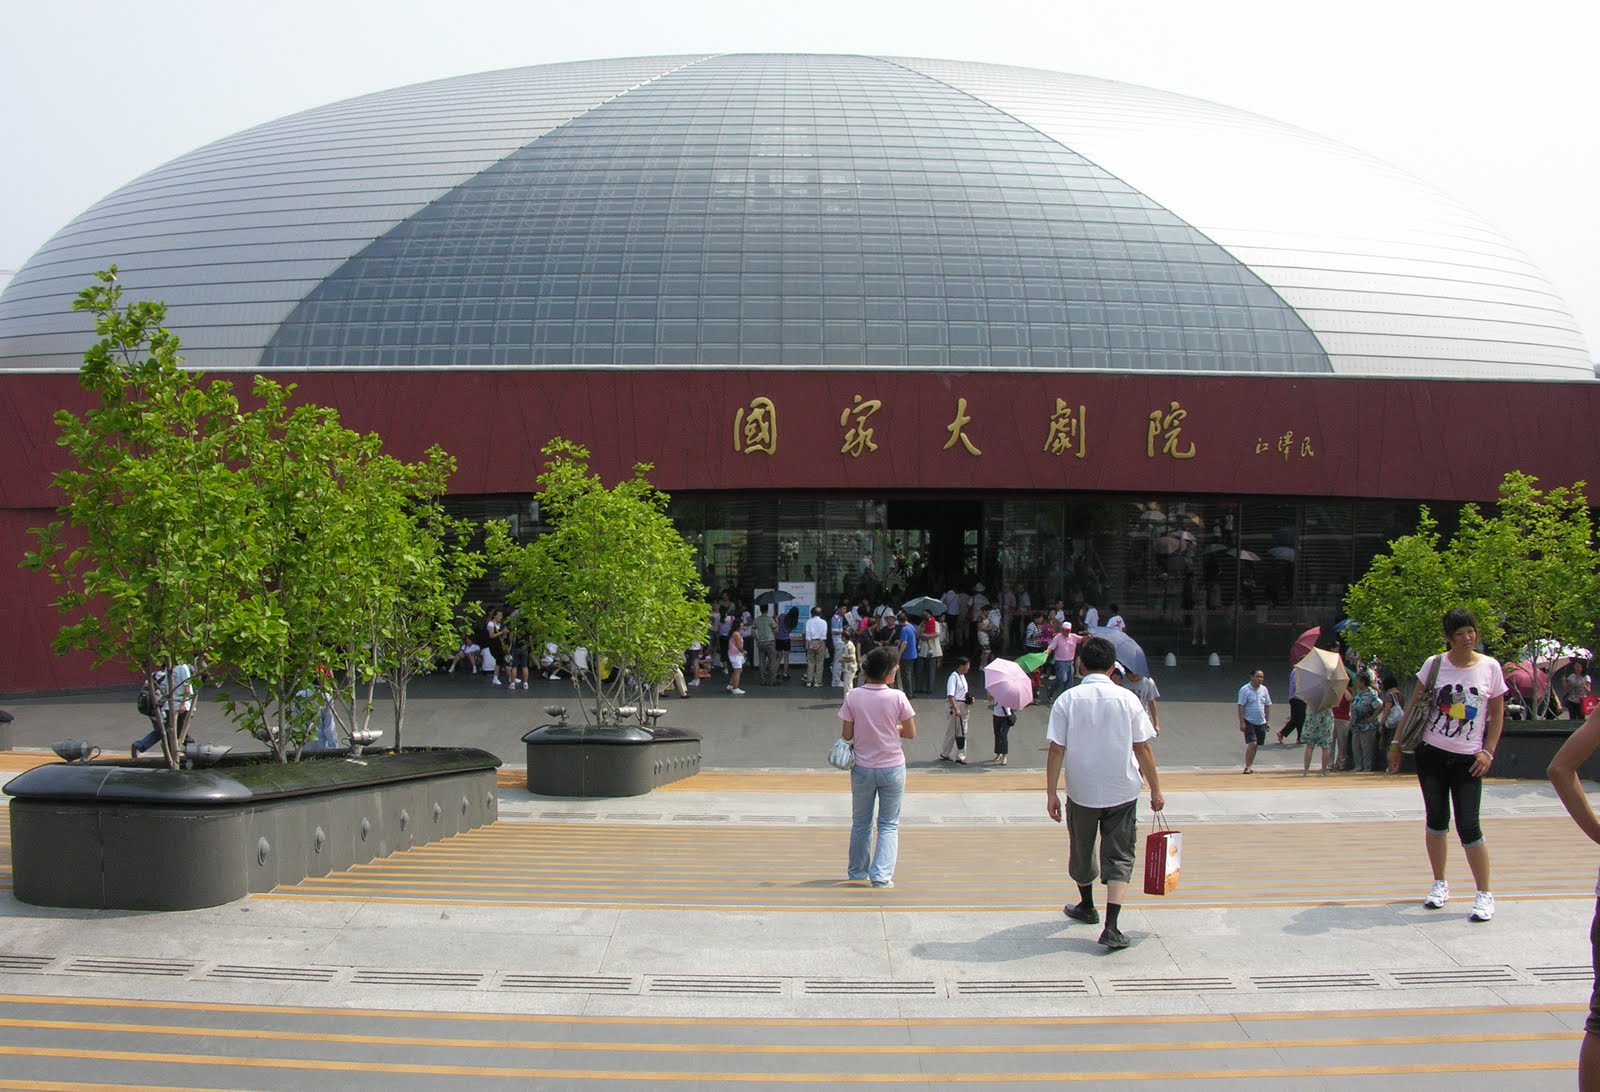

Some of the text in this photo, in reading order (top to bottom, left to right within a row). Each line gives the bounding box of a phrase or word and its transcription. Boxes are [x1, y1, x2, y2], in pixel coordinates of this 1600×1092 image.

[733, 395, 1196, 458] 國家大劇院
